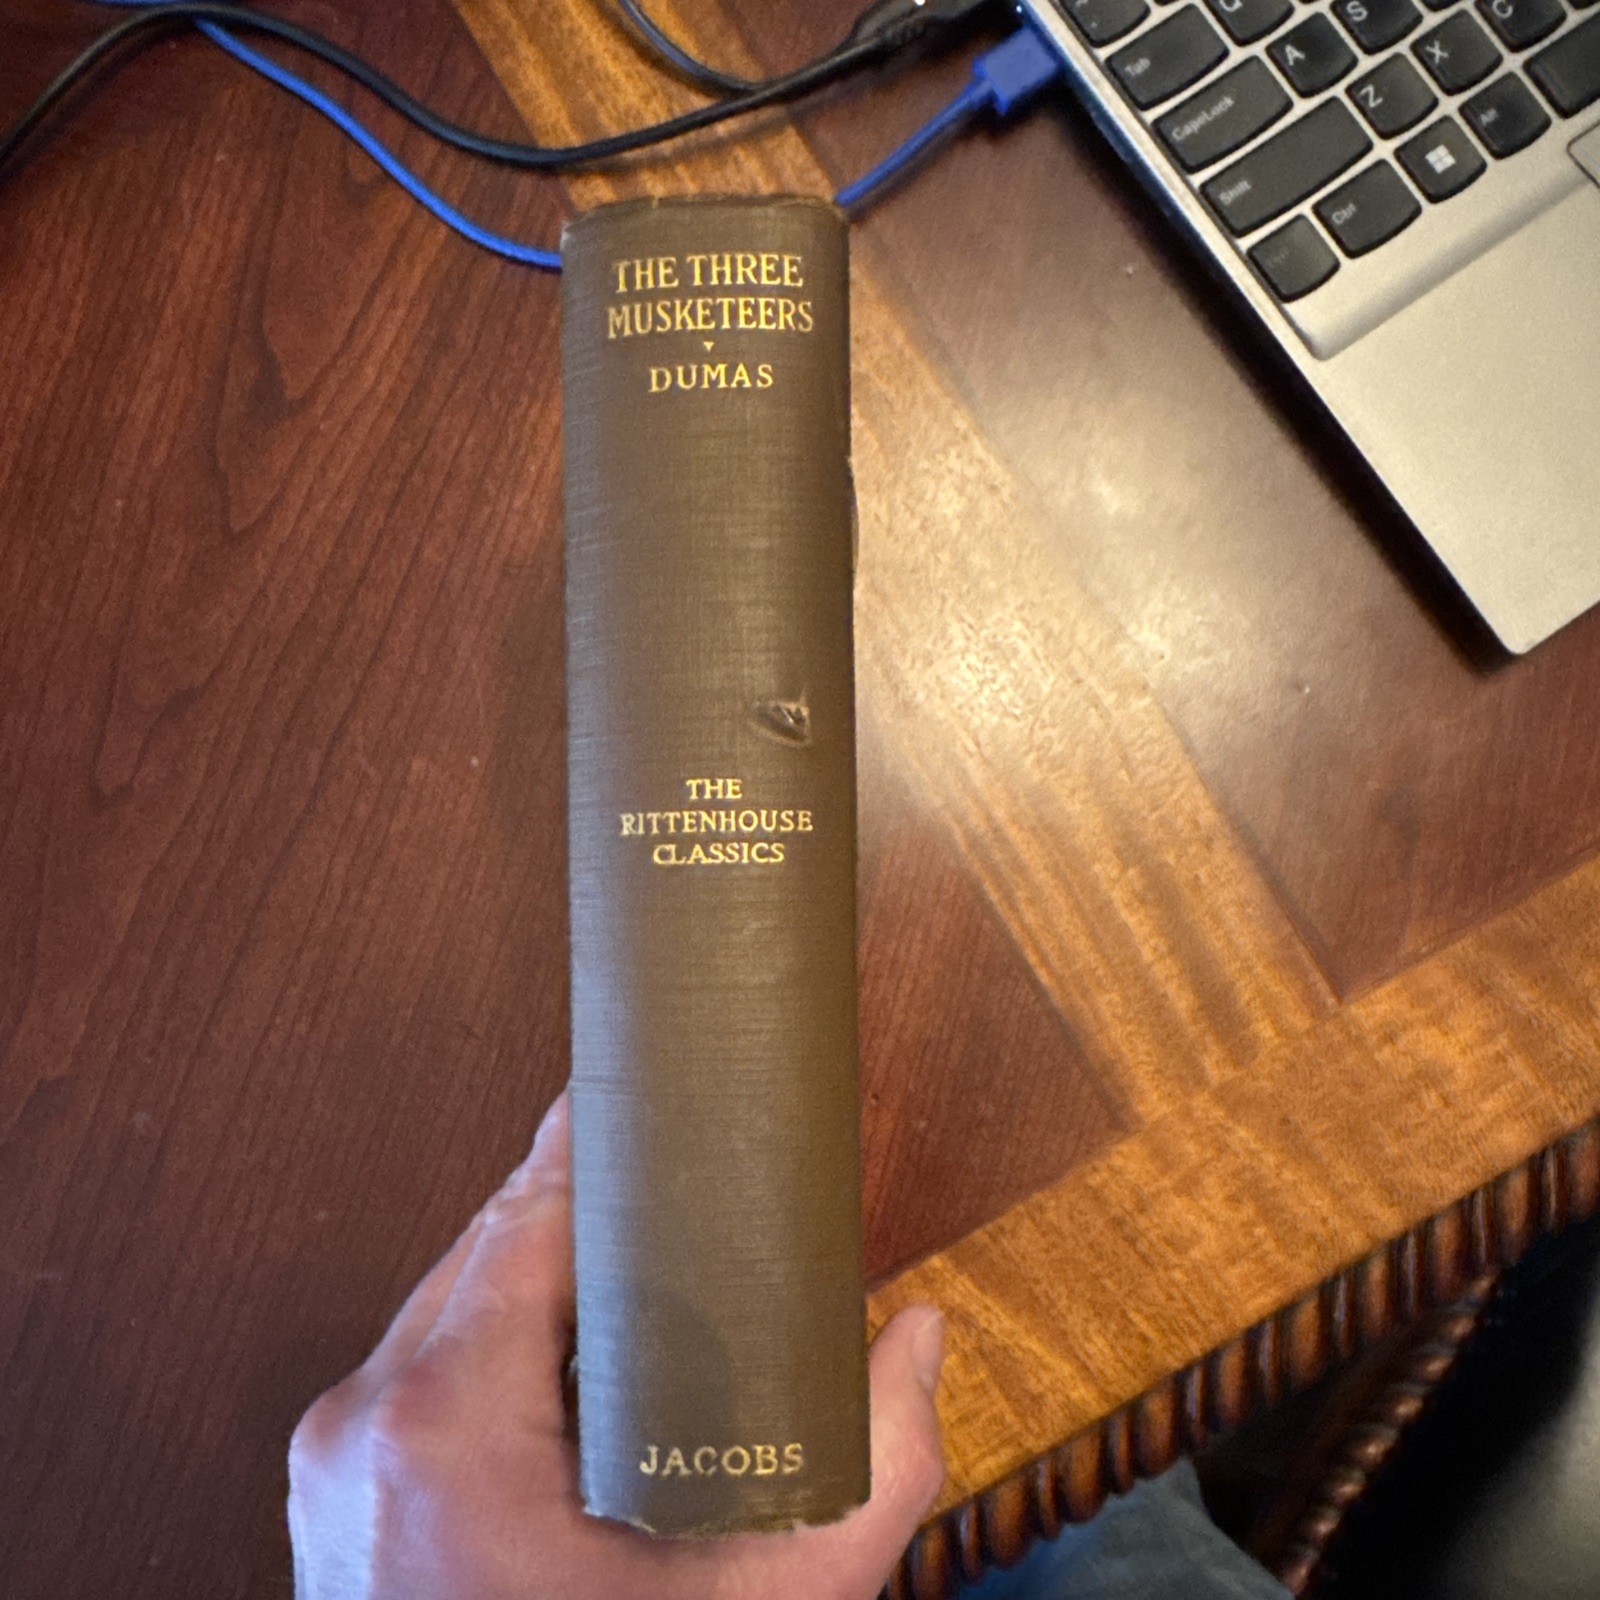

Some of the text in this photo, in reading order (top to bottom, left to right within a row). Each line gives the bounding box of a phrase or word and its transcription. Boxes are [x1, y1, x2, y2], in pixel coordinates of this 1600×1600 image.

[1346, 0, 1368, 22] S
[1492, 0, 1514, 19] C
[1284, 44, 1306, 67] A
[1425, 40, 1449, 64] X
[1124, 56, 1151, 78] Tab
[1359, 83, 1384, 109] Z
[614, 252, 804, 294] THE THREE
[607, 297, 814, 340] MUSKETEERS
[648, 362, 774, 393] DUMAS
[685, 778, 743, 800] THE
[619, 810, 814, 836] RITTENHOUSE
[652, 842, 785, 865] CLASSICS
[639, 1442, 805, 1477] JACOBS
